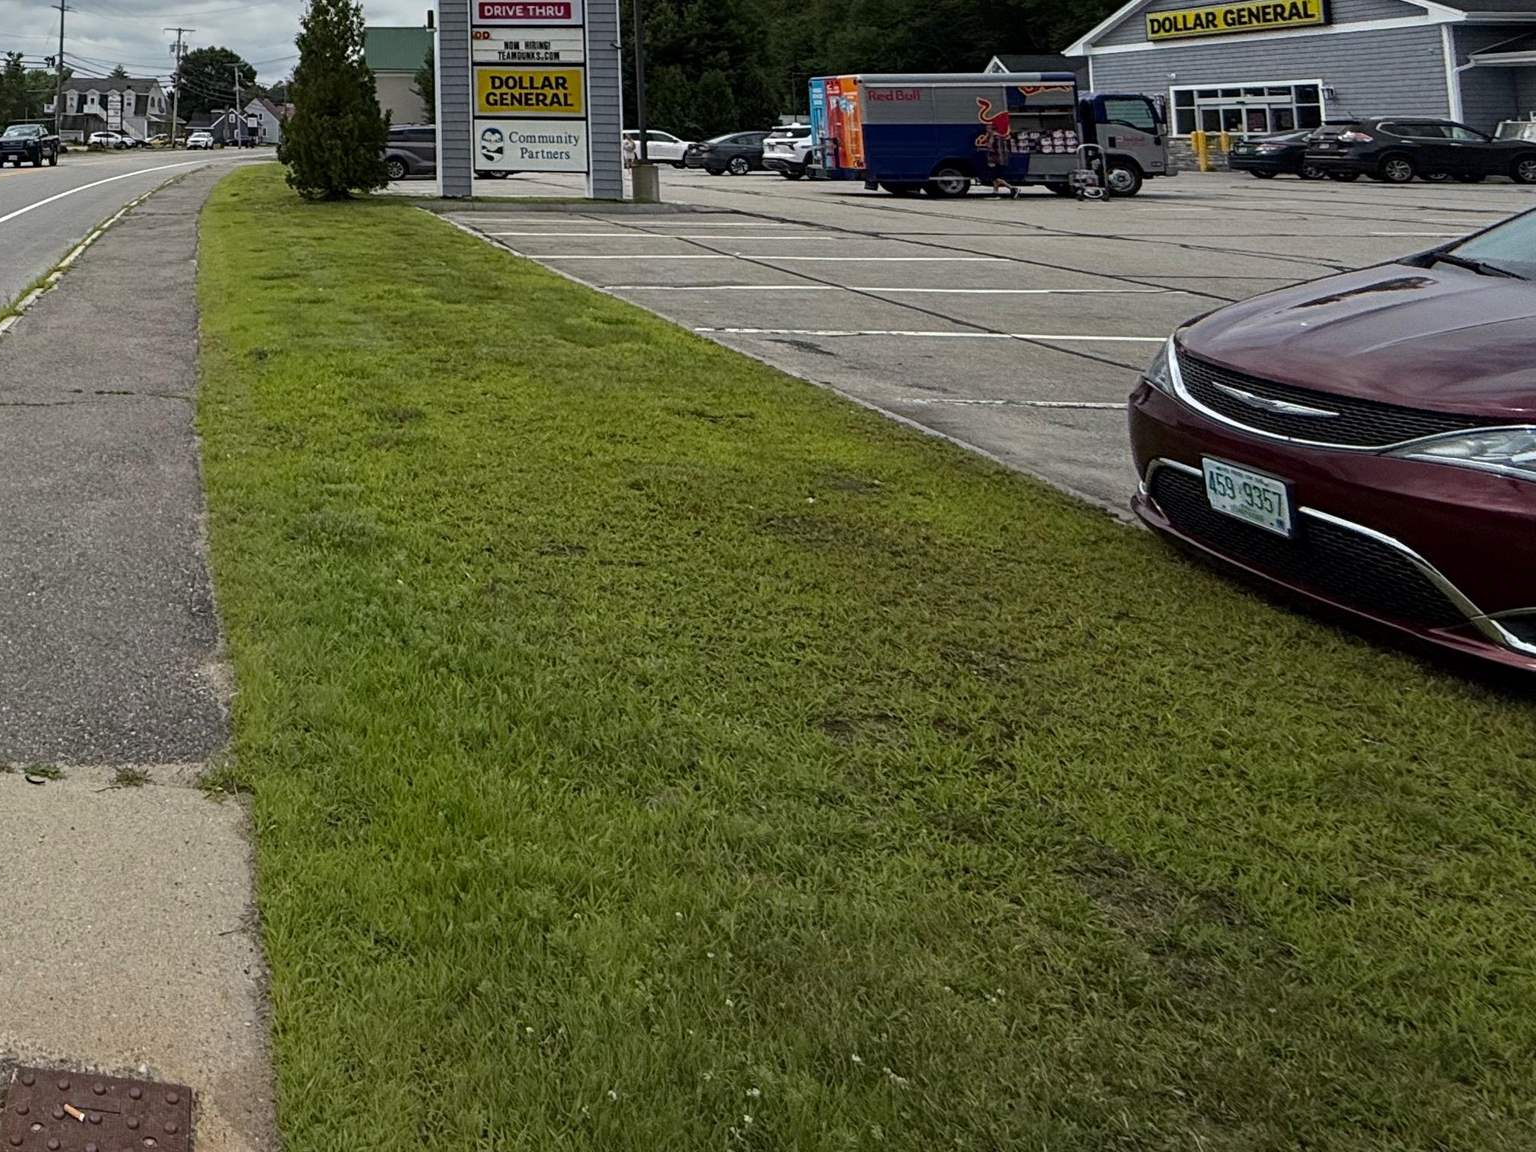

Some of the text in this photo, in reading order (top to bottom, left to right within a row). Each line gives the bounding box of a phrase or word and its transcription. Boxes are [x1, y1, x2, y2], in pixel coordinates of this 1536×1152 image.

[484, 5, 564, 16] DRIVE THRU
[1149, 0, 1315, 35] DOLLAR GENERAL
[504, 41, 519, 50] NOW
[490, 76, 568, 90] DOLLAR
[485, 93, 573, 107] GENERAL
[868, 90, 894, 102] Red
[896, 90, 920, 102] Bull
[509, 131, 580, 147] Community
[520, 148, 571, 160] Partners
